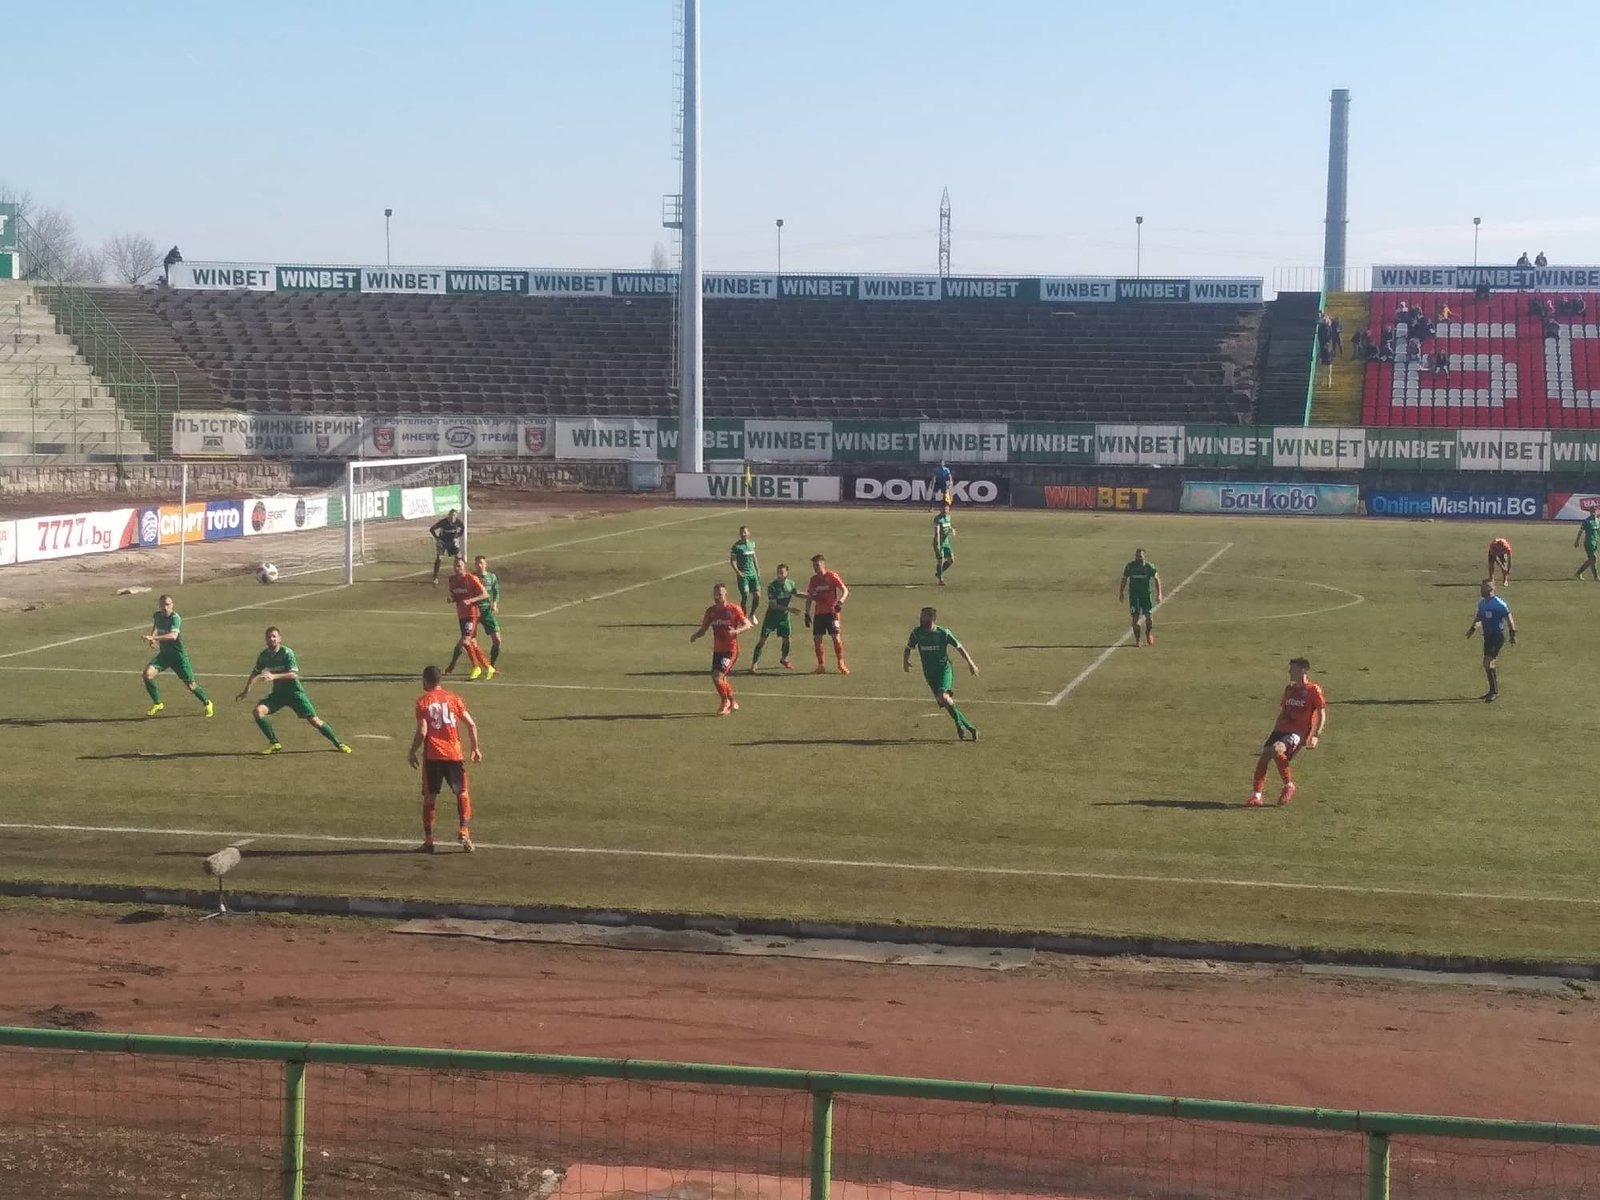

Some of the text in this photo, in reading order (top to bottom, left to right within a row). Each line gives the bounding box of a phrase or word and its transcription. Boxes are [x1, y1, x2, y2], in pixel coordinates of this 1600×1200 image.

[192, 268, 270, 287] WINBET
[281, 270, 357, 289] WINBET
[366, 273, 441, 290] WINBET
[450, 273, 524, 292] WINBET
[534, 275, 607, 292] WINBET
[617, 276, 678, 293] WINBE
[1381, 269, 1456, 285] WINBET
[1458, 270, 1534, 286] WINBET
[1535, 270, 1600, 286] WINBE
[782, 279, 854, 296] WINBET
[864, 280, 937, 297] WINBET
[946, 281, 1019, 297] WINBET
[1045, 282, 1111, 297] WINBET
[1120, 283, 1185, 298] WINBET
[1195, 284, 1260, 299] WINBET
[245, 436, 294, 450] ВРАЦА
[402, 432, 440, 442] ИНЕКС
[572, 429, 654, 448] WINBET
[659, 430, 742, 448] WBET
[747, 431, 830, 450] WINBET
[833, 432, 917, 450] WINBET
[921, 433, 1006, 451] WINBET
[1010, 434, 1094, 452] WINBET
[1098, 435, 1182, 454] WINBET
[1186, 436, 1271, 456] WINBET
[1277, 438, 1361, 457] WINBET
[1367, 440, 1454, 459] WINBET
[1459, 441, 1547, 460] WINBET
[1553, 442, 1600, 461] WIN
[707, 475, 808, 498] WINBET
[1044, 485, 1148, 510] WINBET
[1219, 488, 1318, 512] Бачково
[1372, 496, 1536, 516] OnlineMashini.BG
[38, 518, 111, 549] 7777.bg
[428, 702, 456, 730] 94
